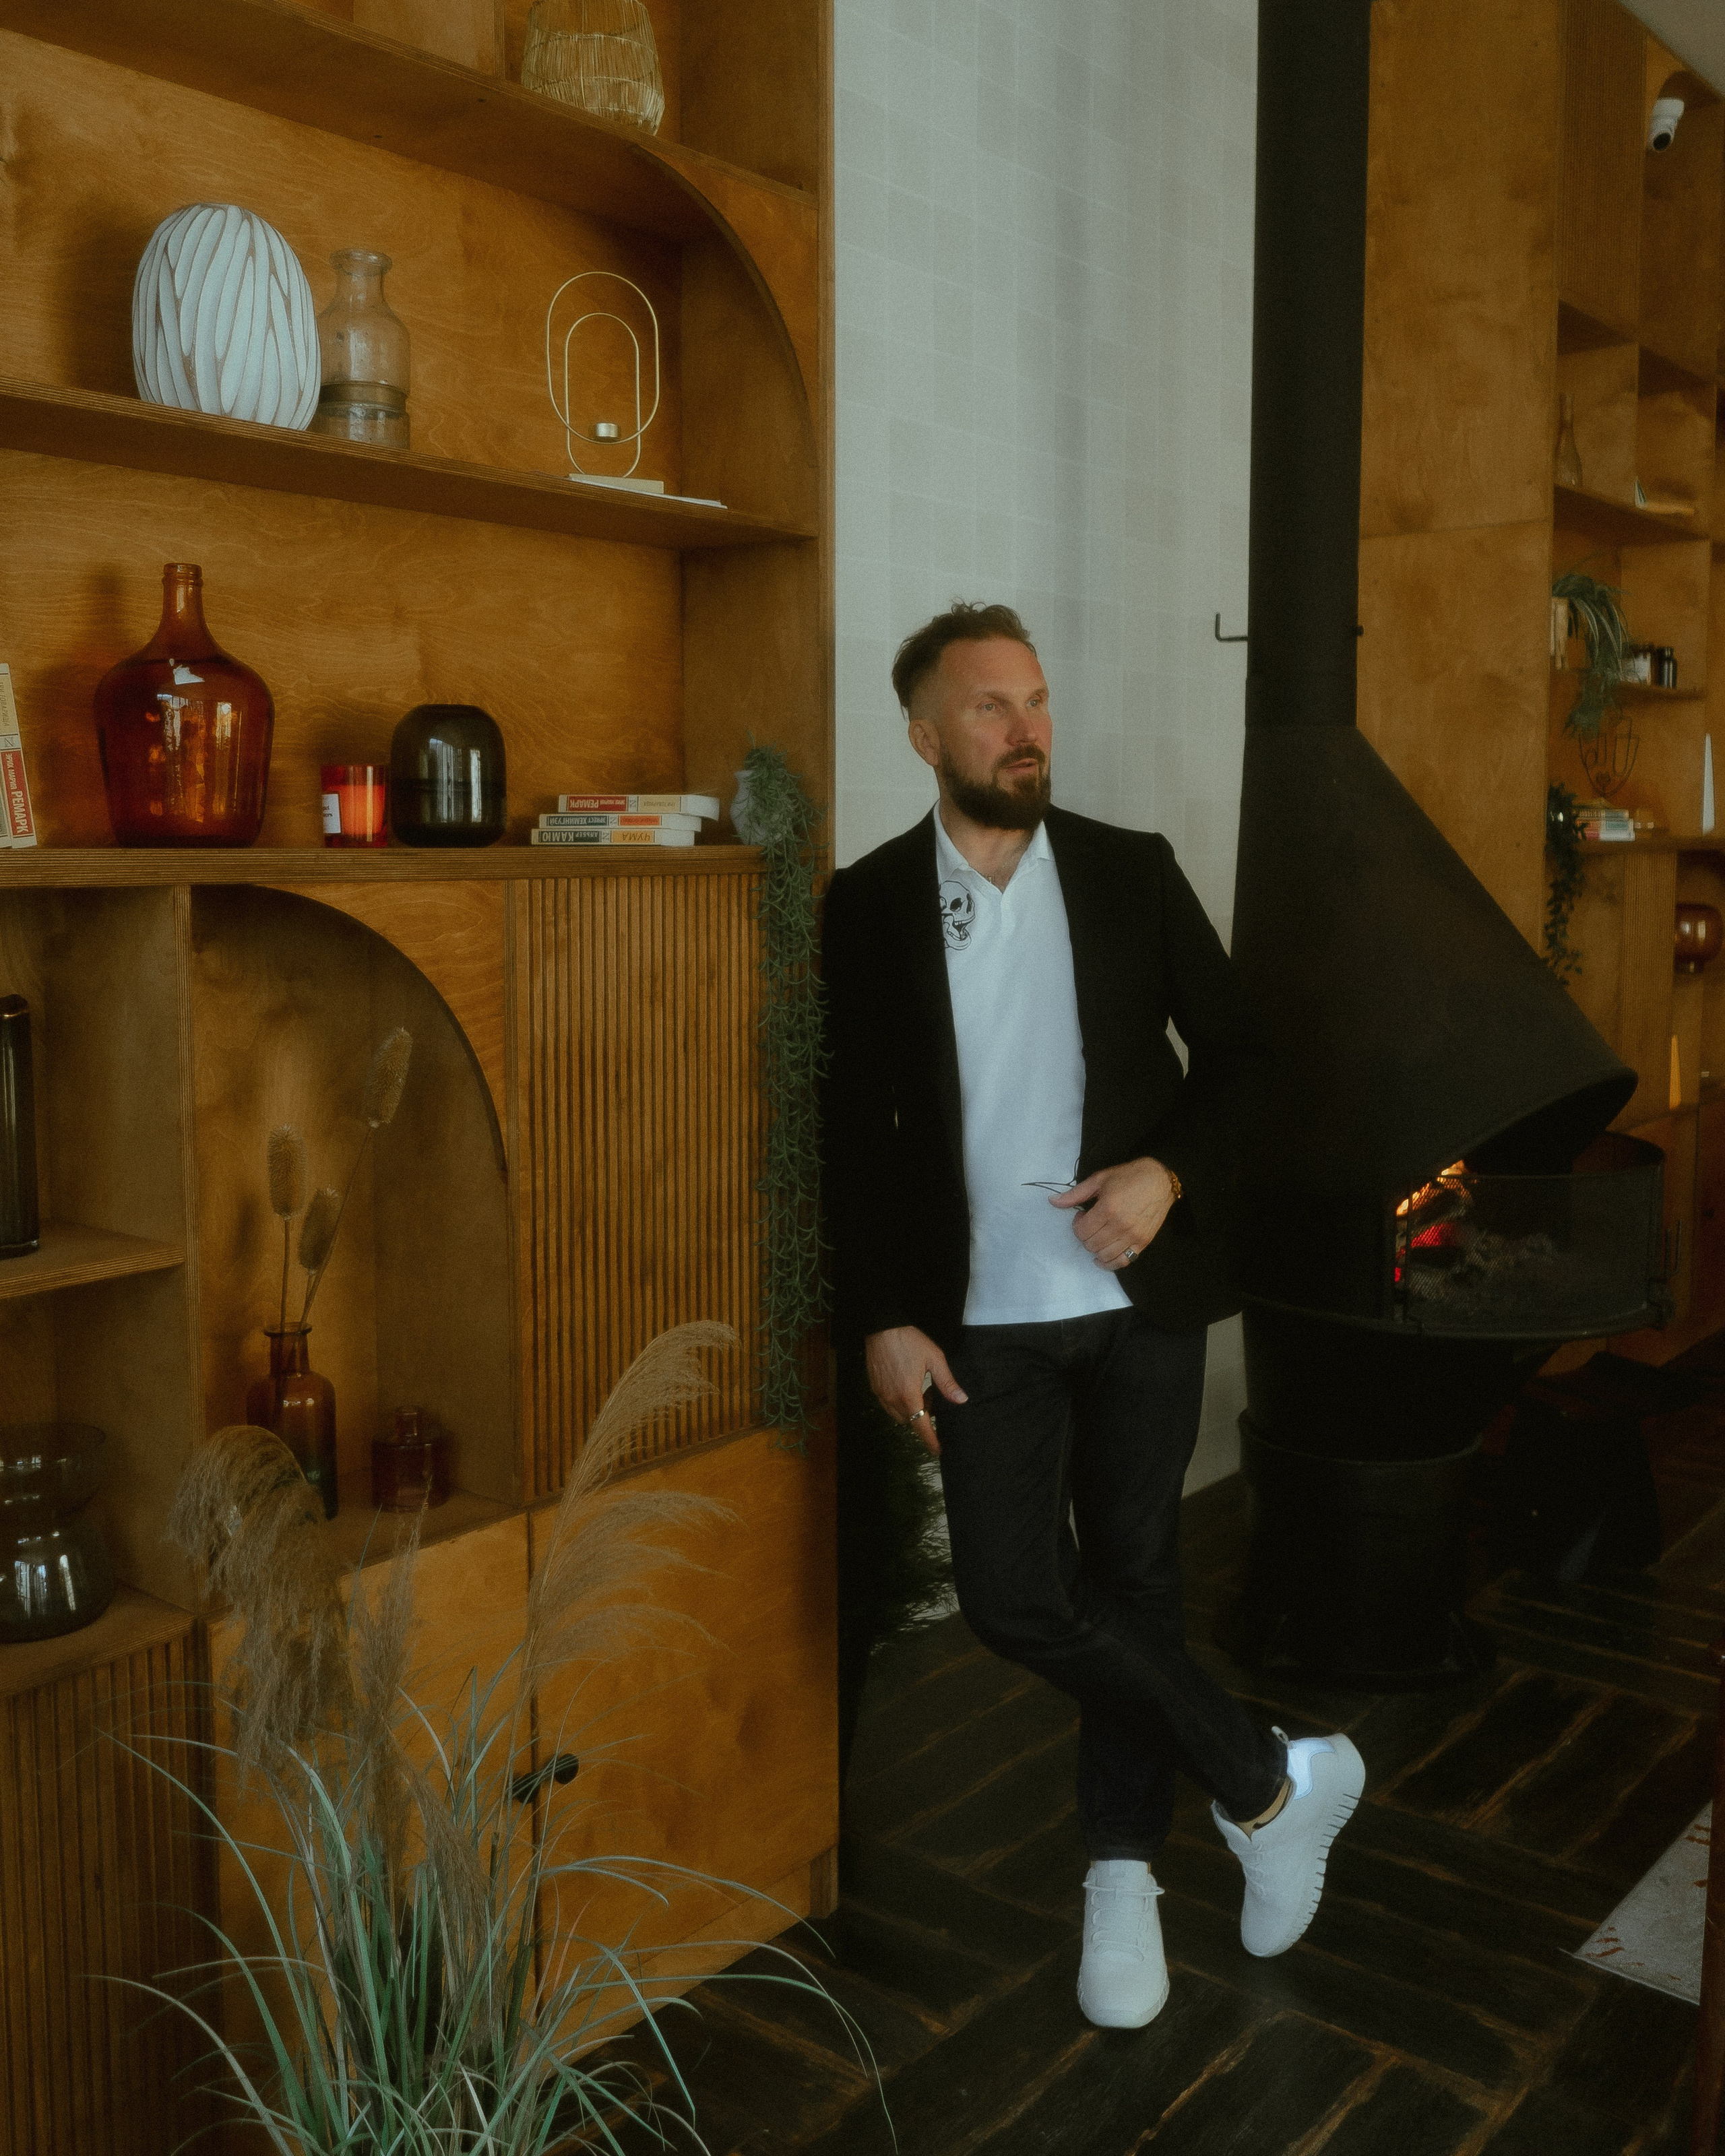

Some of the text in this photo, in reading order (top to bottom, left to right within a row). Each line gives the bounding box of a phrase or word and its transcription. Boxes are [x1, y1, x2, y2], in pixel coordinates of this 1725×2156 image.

[0, 695, 10, 726] ТОВАРИЩА
[5, 753, 28, 833] ЭРИХ МАРИЯ РЕМАРК
[569, 799, 599, 808] РЕМАРК
[550, 817, 588, 825] ХЕМИНГУЭЙ
[542, 831, 574, 842] КАМЮ
[622, 833, 650, 841] ЧУМА
